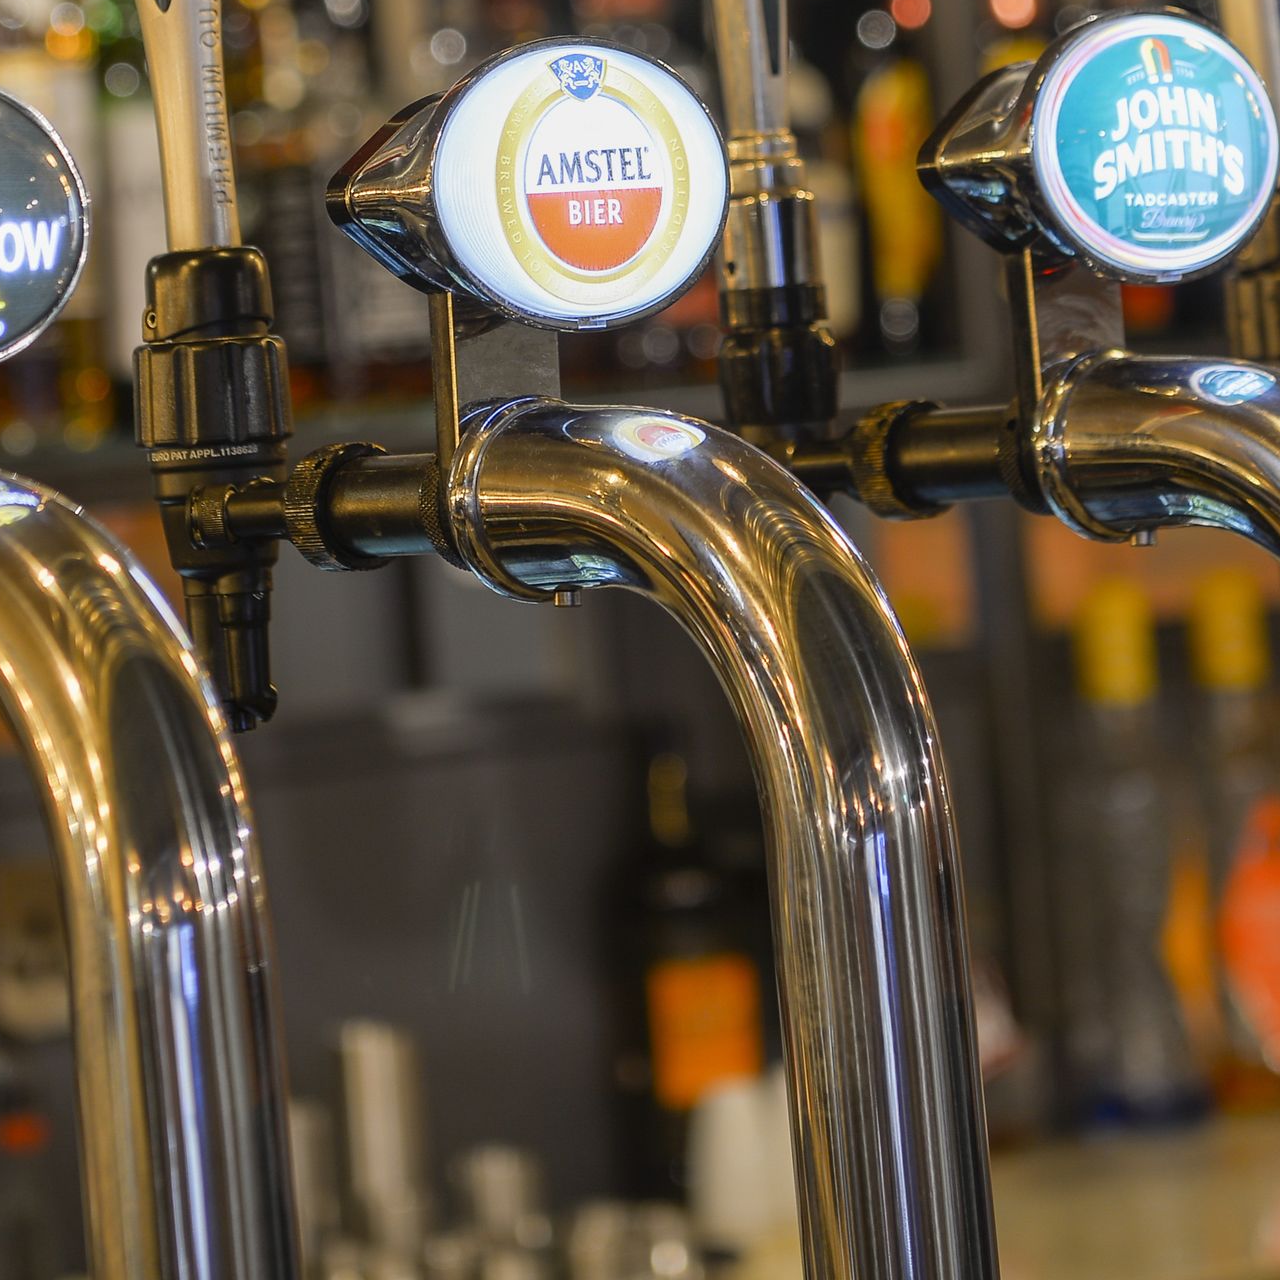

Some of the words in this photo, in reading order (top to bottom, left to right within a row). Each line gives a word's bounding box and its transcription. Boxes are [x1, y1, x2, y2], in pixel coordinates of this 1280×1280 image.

[200, 63, 233, 208] PREMIUM
[1111, 86, 1219, 141] JOHN
[536, 146, 651, 186] AMSTEL
[1093, 129, 1245, 201] SMITH'S
[499, 154, 522, 244] BREWED
[568, 198, 624, 226] BIER
[1124, 191, 1219, 208] TADCASTER
[170, 450, 189, 461] PAT
